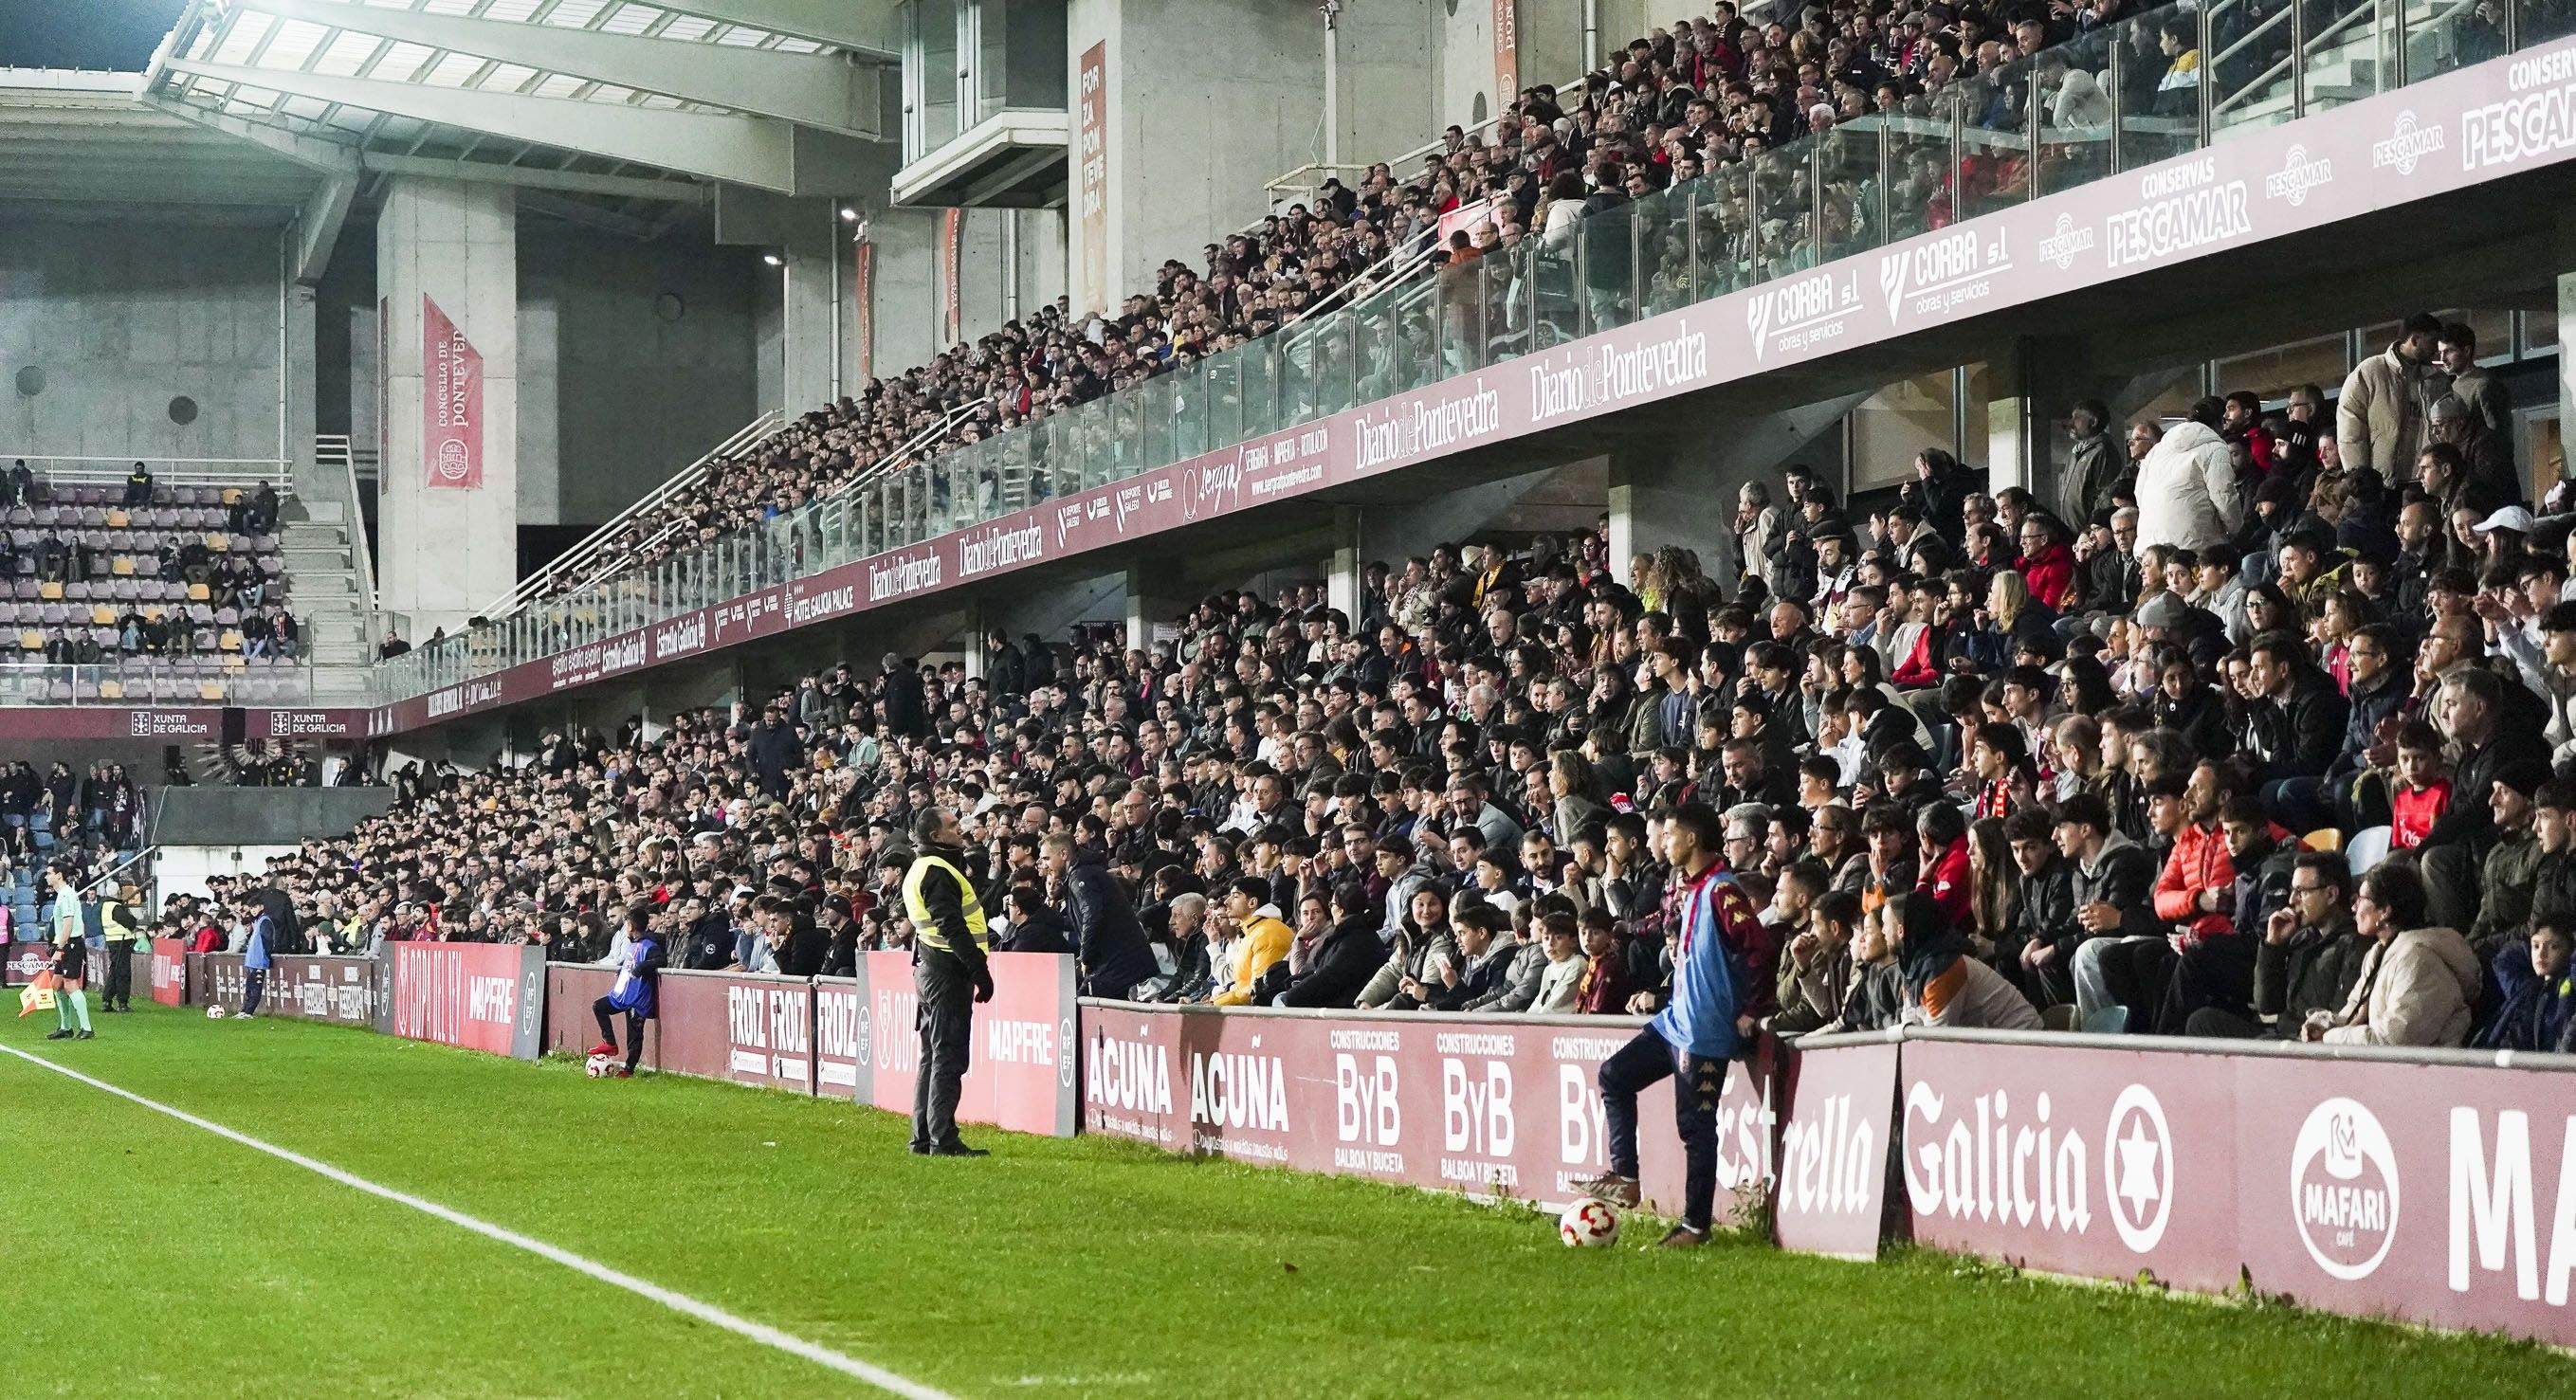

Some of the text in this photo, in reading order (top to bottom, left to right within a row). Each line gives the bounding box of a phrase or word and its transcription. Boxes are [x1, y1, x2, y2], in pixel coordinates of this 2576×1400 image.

[2372, 124, 2446, 169] PESCAMAR
[2141, 156, 2215, 201] CONSERVAS
[2266, 157, 2333, 200] PESCAMAR
[2038, 227, 2094, 264] PESCAMAR
[2106, 179, 2252, 269] PESCAMAR
[1914, 230, 1978, 287] CORBA
[1777, 272, 1834, 326] CORBA
[1915, 280, 1990, 316] obras y servicios
[1778, 319, 1844, 353] obras y servicios
[438, 341, 448, 427] CONCELLO DE
[832, 585, 854, 612] PALACE
[153, 714, 187, 723] XUNTA
[153, 724, 208, 734] DE GALICIA
[292, 714, 326, 723] XUNTA
[292, 724, 346, 734] DE GALICIA
[410, 948, 431, 1039] COPA
[468, 974, 515, 1025] MAPFRE
[728, 985, 808, 1053] FROIZ FROIZ
[817, 992, 857, 1059] FROIZ
[894, 992, 922, 1073] COP
[988, 1018, 1053, 1065] MAPFRE
[1330, 1029, 1400, 1052] CONSTRUCCIONES
[1436, 1032, 1515, 1057] CONSTRUCCIONES
[1087, 1023, 1174, 1116] ACUÑA
[1190, 1033, 1290, 1133] ACUÑA
[1334, 1148, 1404, 1174] BALBOA Y BUCETA
[1440, 1158, 1518, 1187] BALBOA Y BUCETA
[1903, 1081, 2092, 1235] Galicia
[2304, 1183, 2385, 1231] MAFARI
